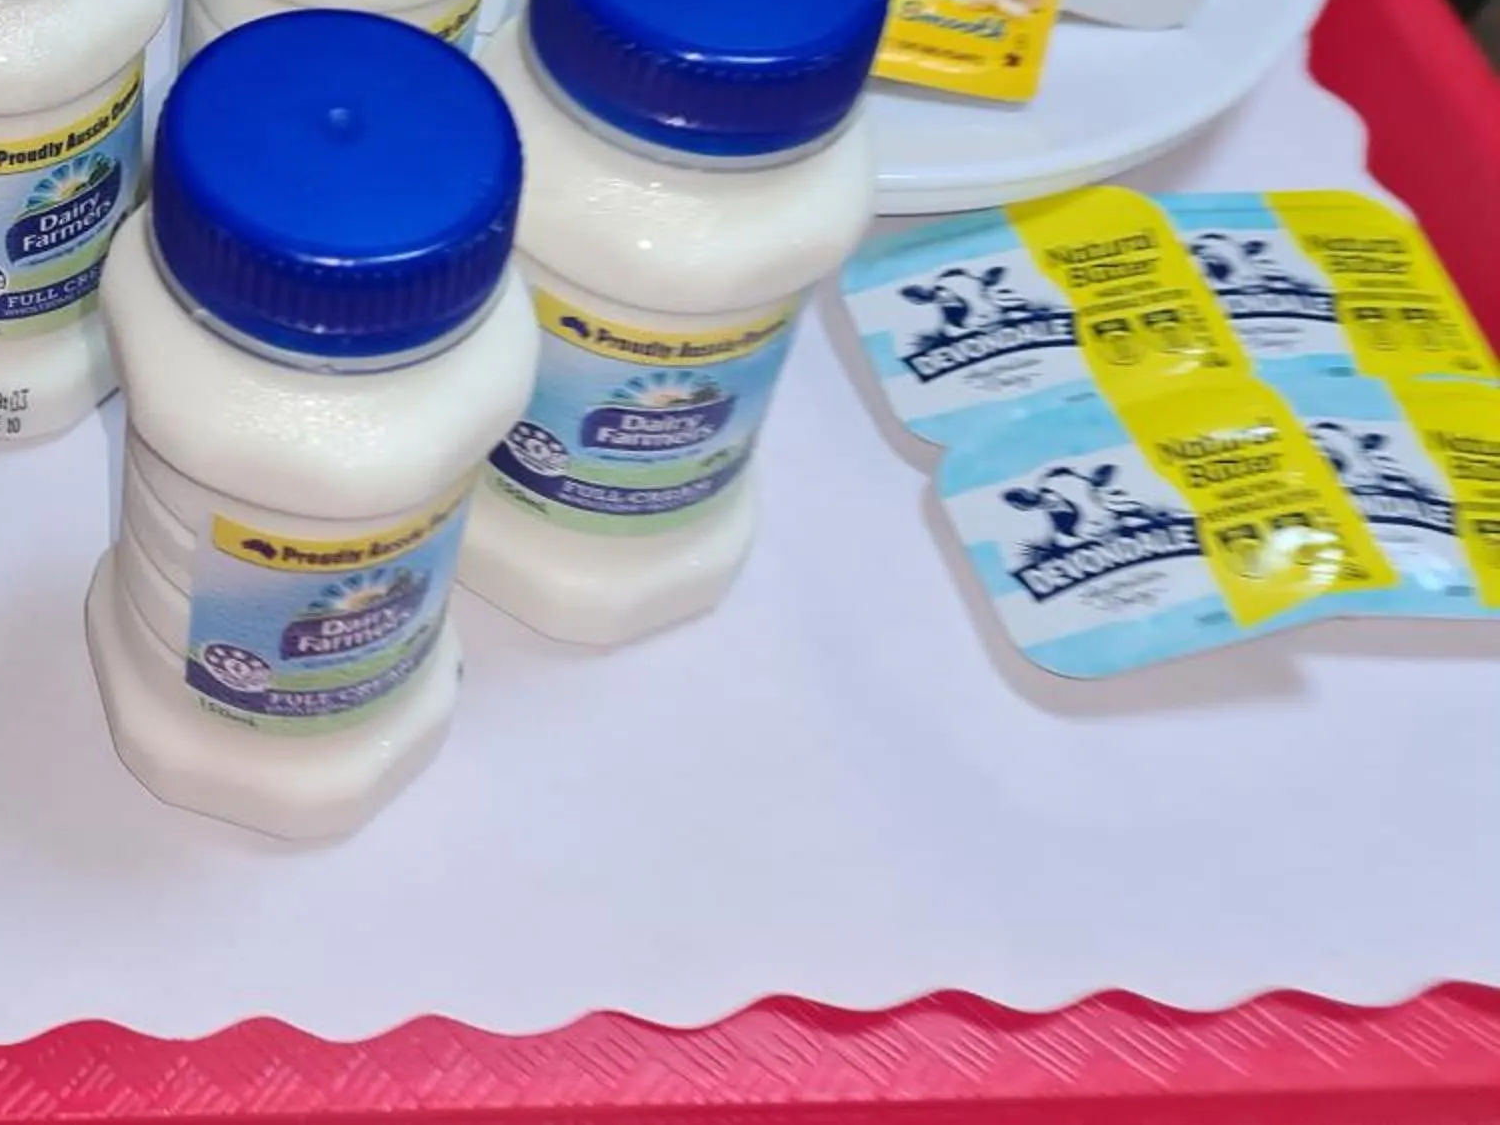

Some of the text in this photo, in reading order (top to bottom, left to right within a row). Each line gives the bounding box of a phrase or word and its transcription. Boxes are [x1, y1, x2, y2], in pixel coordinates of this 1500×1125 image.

[65, 115, 110, 152] Aussie
[22, 200, 112, 252] Farmers
[40, 192, 100, 233] Dairy
[7, 288, 60, 309] FULL
